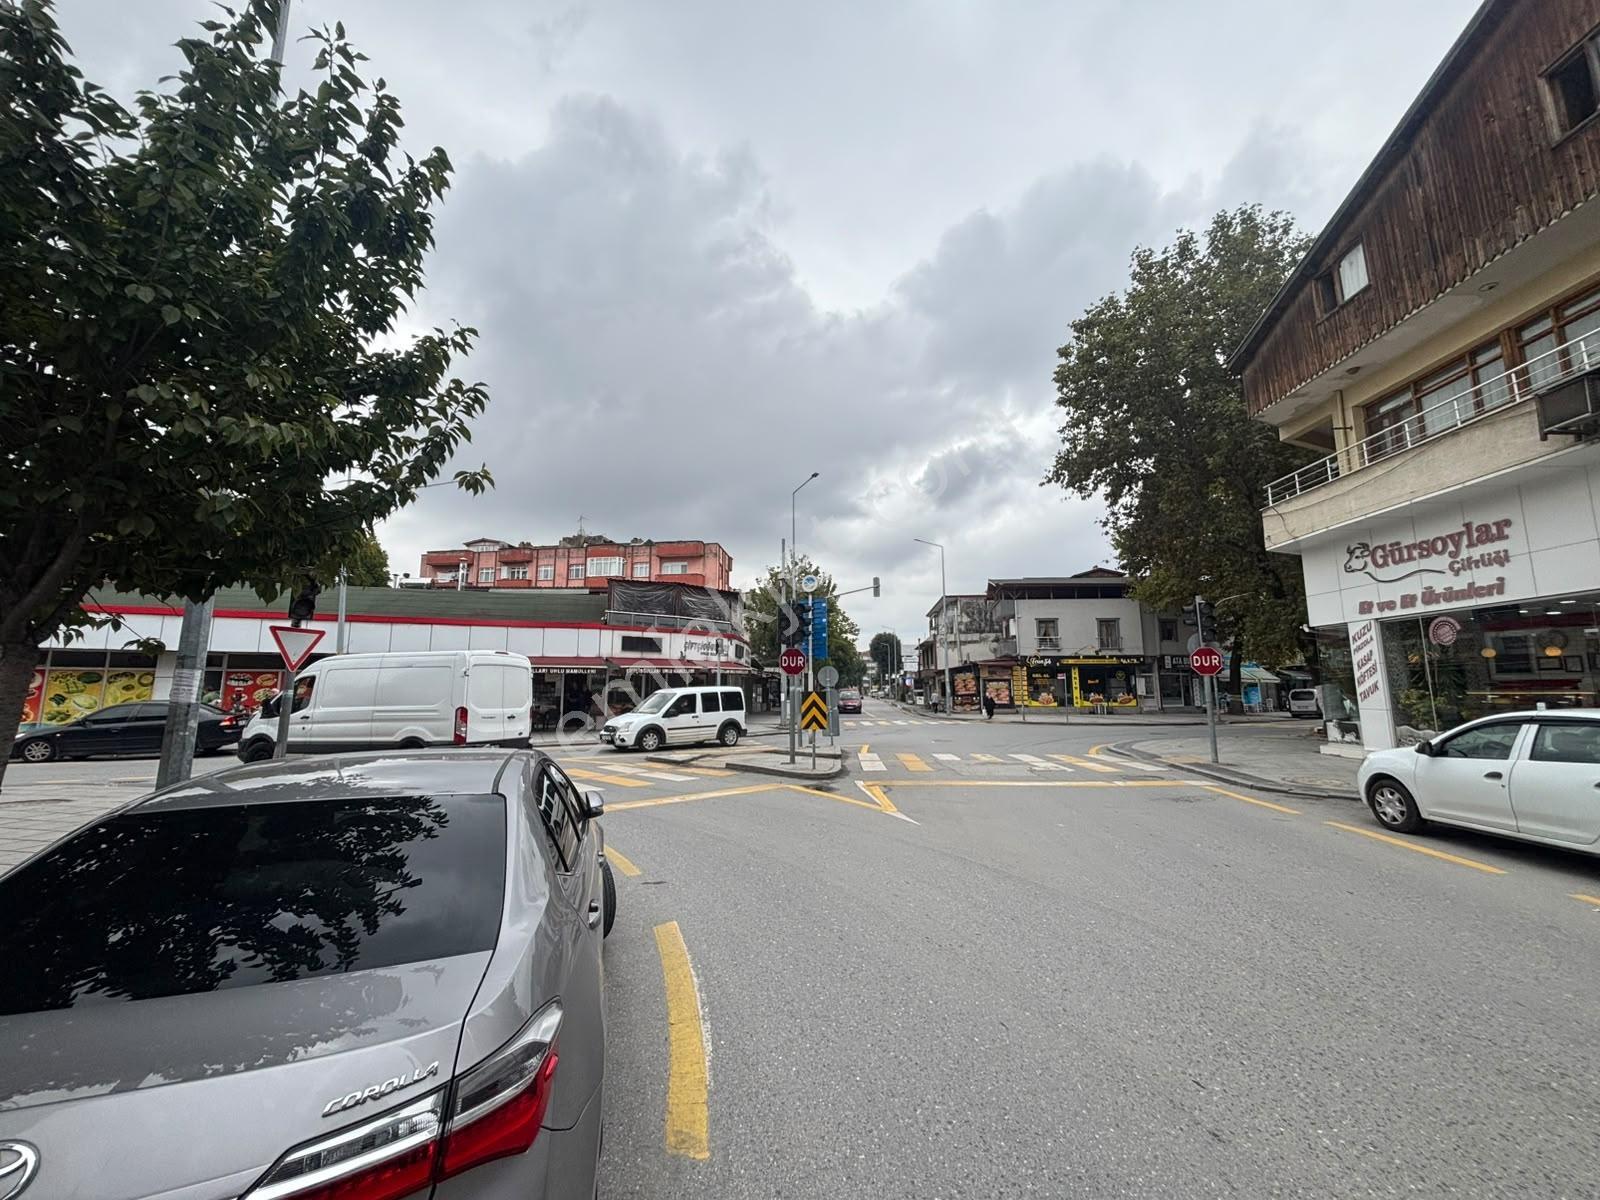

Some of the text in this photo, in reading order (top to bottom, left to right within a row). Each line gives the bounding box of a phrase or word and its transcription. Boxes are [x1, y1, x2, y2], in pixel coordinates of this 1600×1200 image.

[1371, 518, 1513, 569] Gürsoylar
[1448, 549, 1510, 577] Çiftliği
[1376, 599, 1397, 612] ve
[1421, 577, 1506, 606] Ürünleri
[1352, 621, 1372, 645] KUZU
[782, 655, 804, 667] DUR
[1193, 655, 1220, 667] DUR
[1356, 650, 1373, 672] KASAP
[1359, 679, 1380, 703] TAVUK
[321, 1060, 439, 1118] COROLLA
